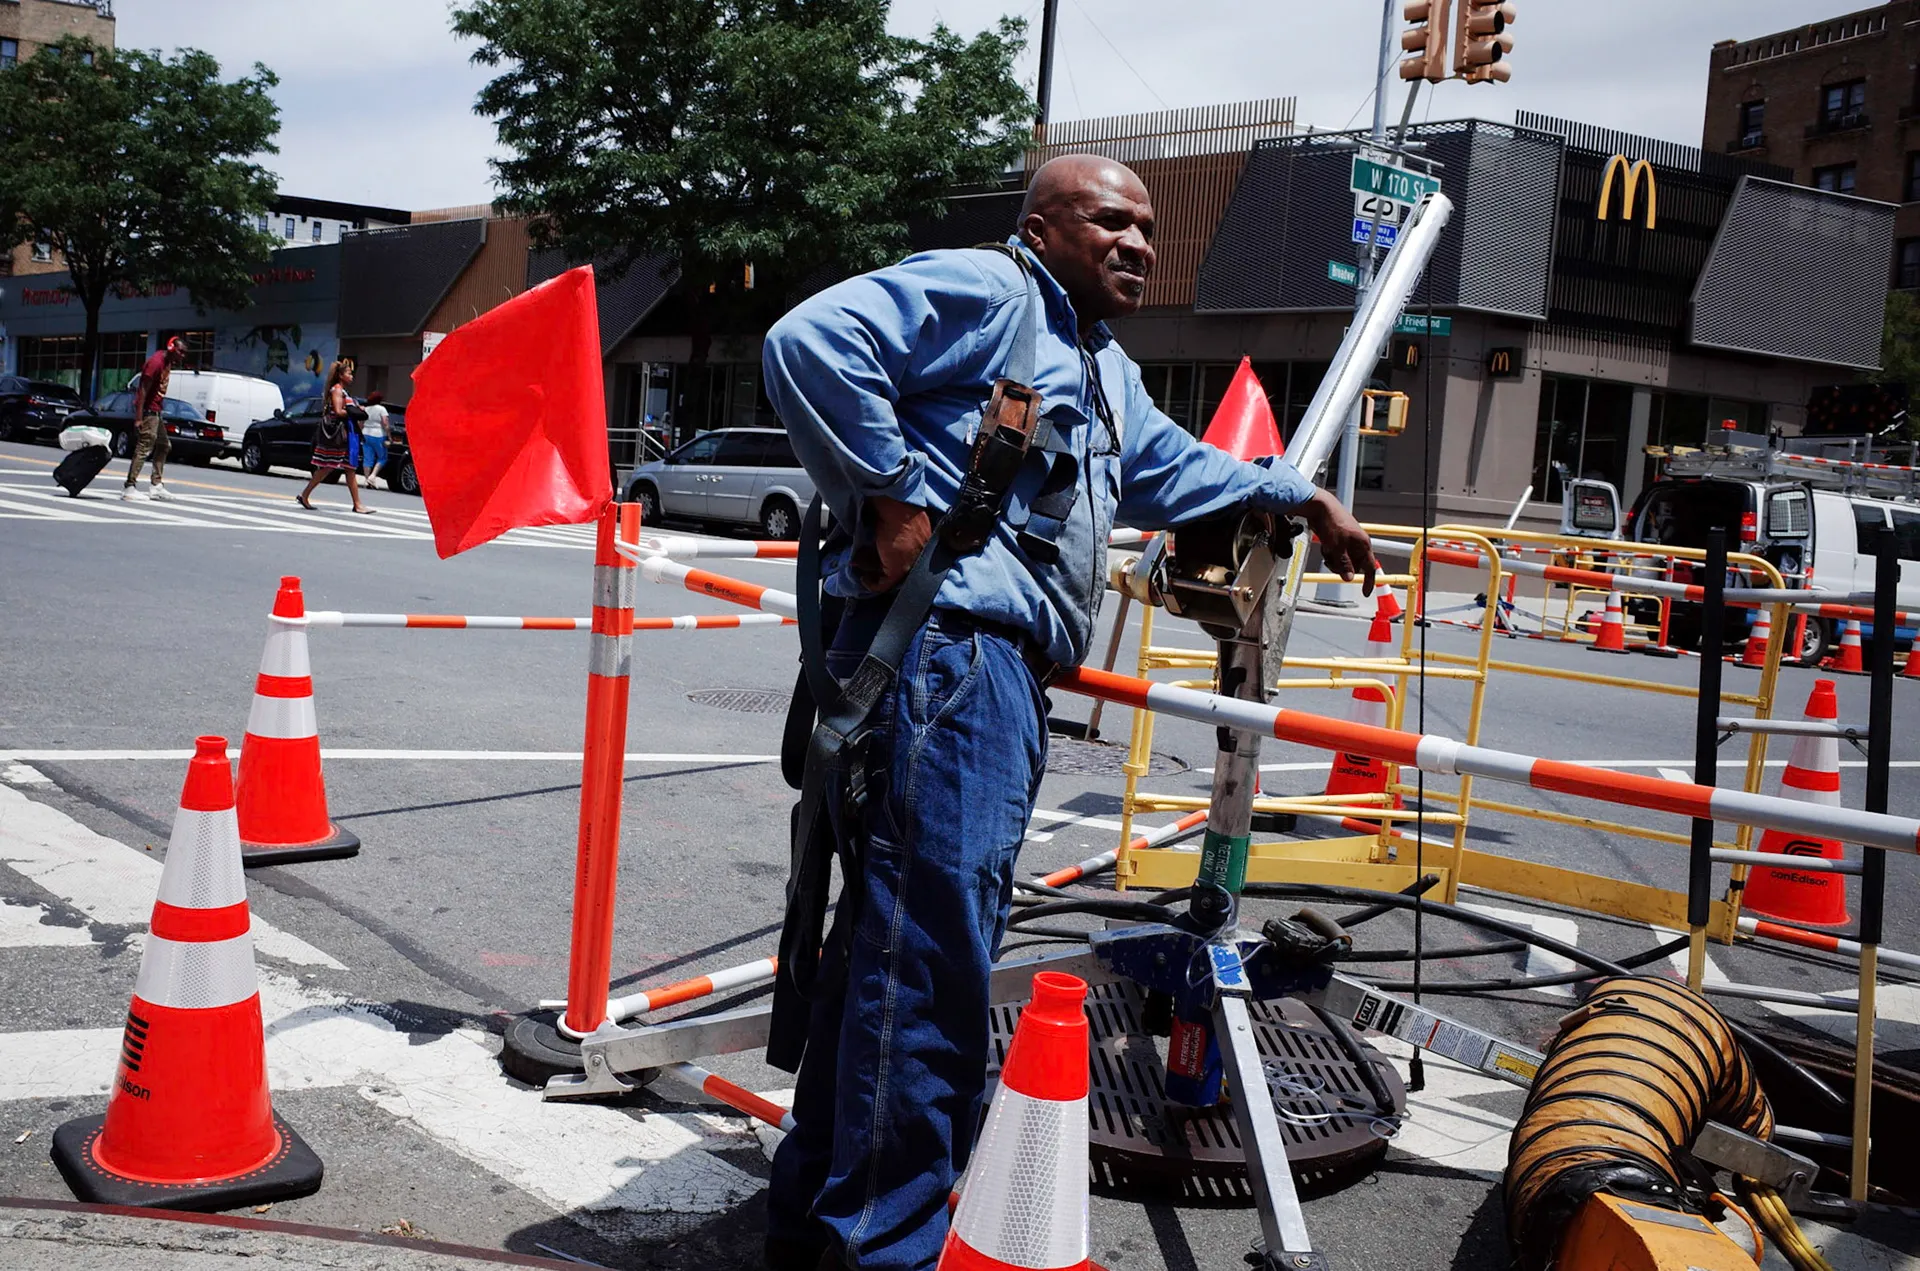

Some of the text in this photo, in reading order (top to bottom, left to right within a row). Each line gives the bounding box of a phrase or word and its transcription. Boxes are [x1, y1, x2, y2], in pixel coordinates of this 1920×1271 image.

[1371, 168, 1424, 200] W 170 St
[1361, 222, 1391, 236] Broway
[22, 287, 70, 307] Pharmacy
[1405, 316, 1441, 328] Friedlnd
[1204, 850, 1216, 873] ONLY
[1770, 871, 1828, 886] conEdison
[1361, 1000, 1375, 1020] SALA
